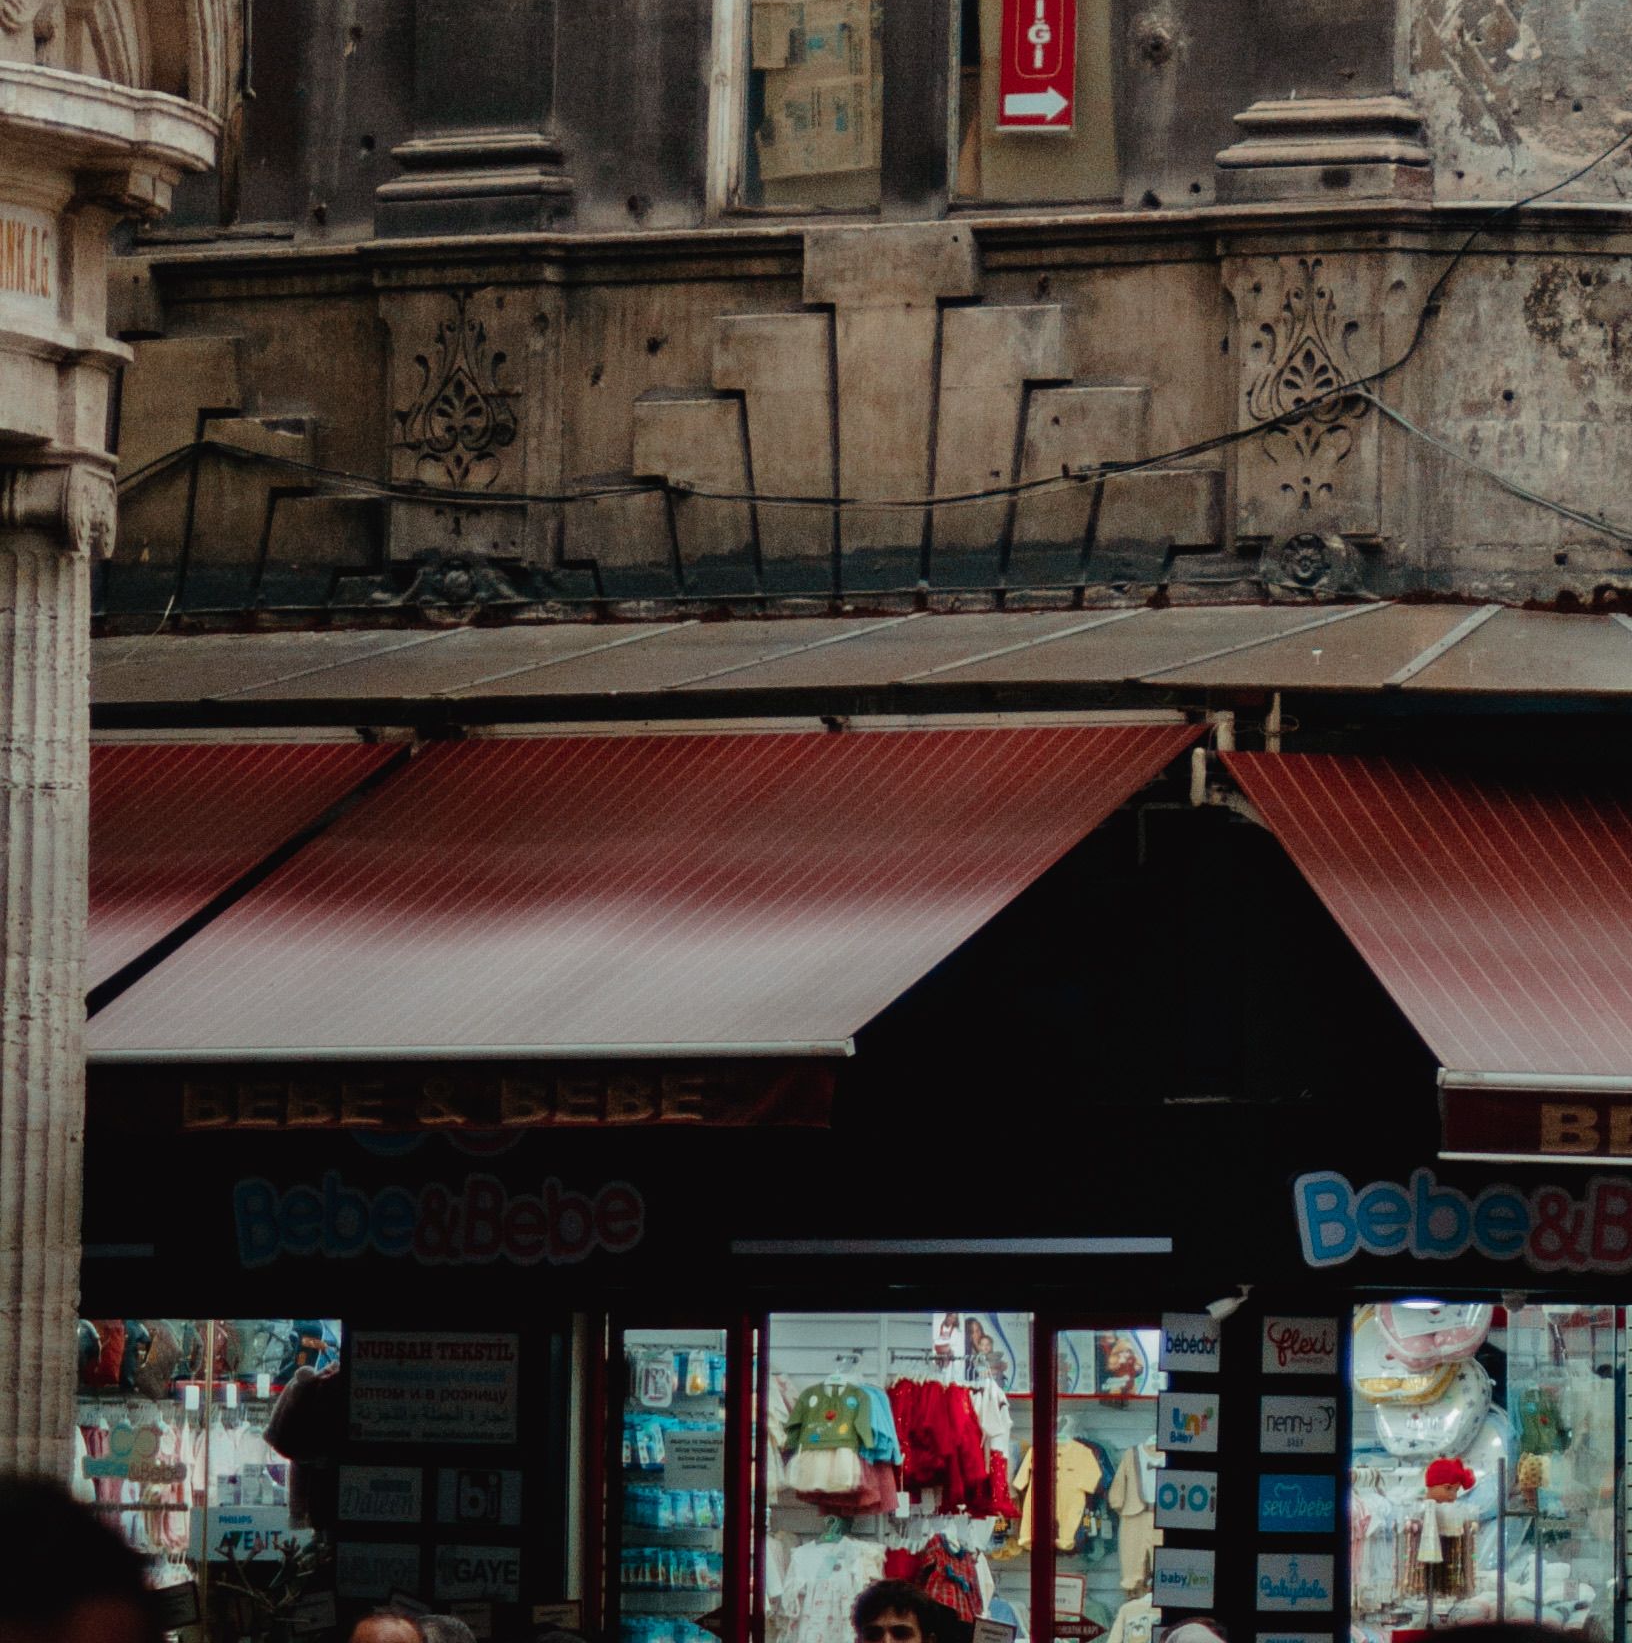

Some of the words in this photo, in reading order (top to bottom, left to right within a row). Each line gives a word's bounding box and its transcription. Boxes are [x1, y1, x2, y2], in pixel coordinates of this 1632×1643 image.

[182, 1081, 383, 1127] BEBE
[500, 1075, 702, 1124] BEBE
[455, 1558, 518, 1585] GAYE
